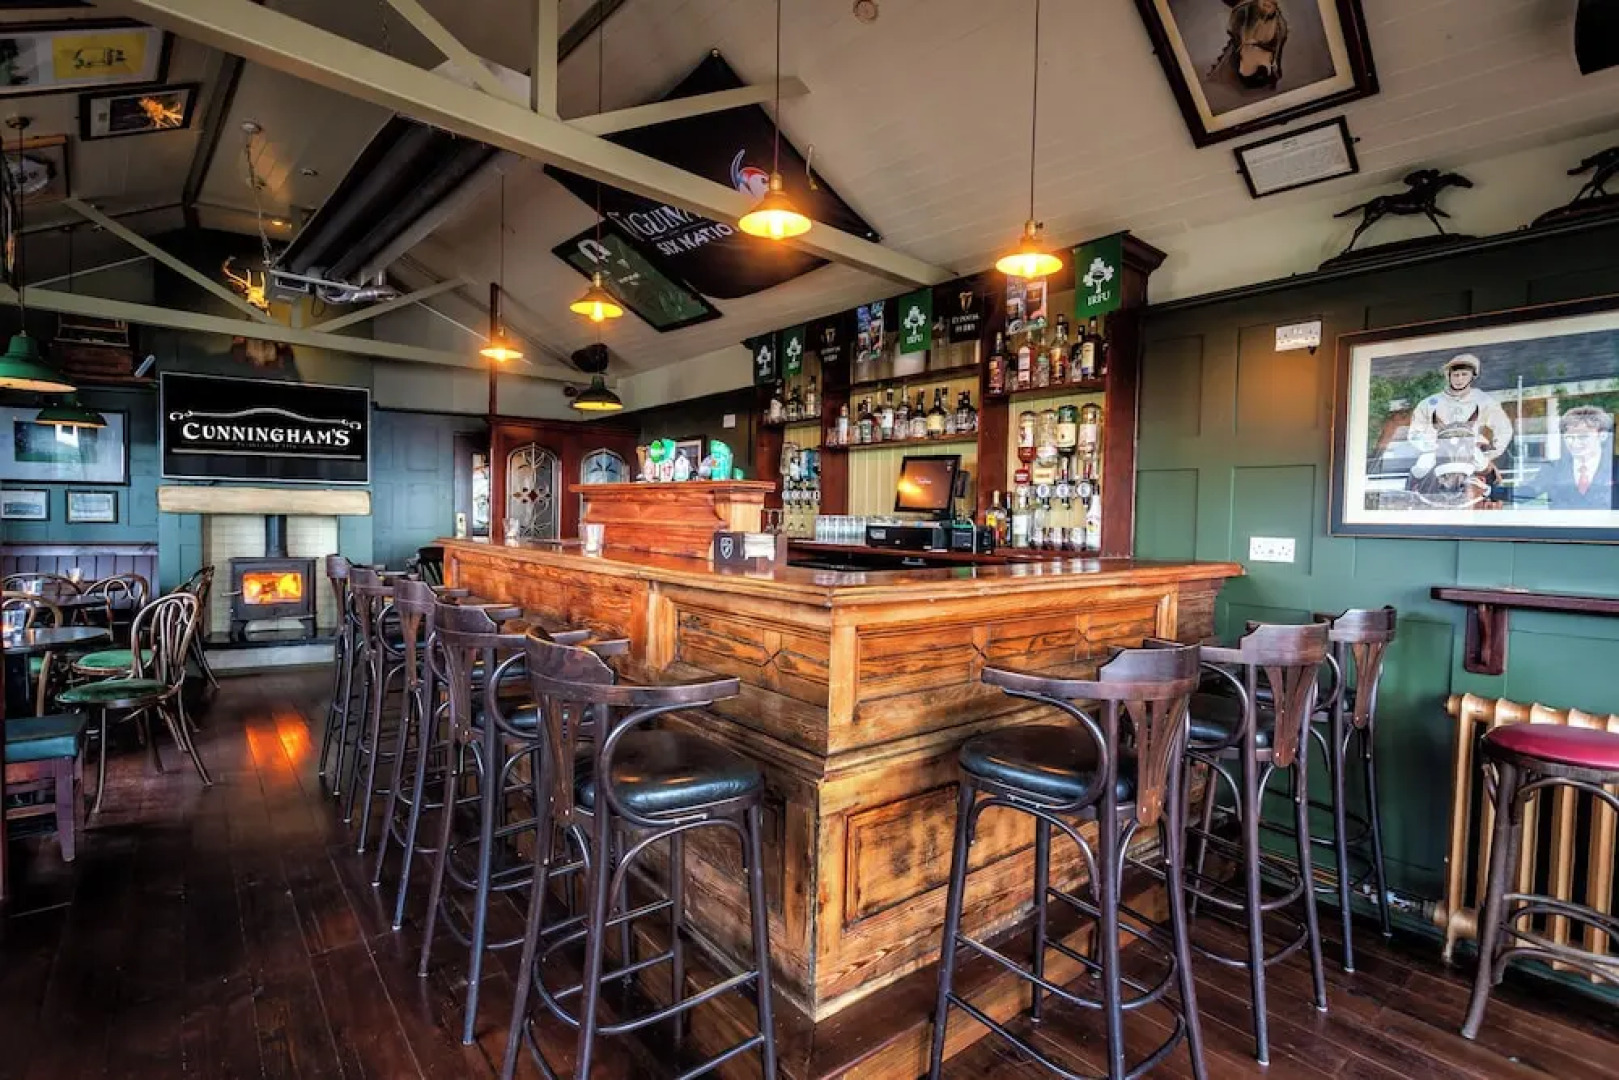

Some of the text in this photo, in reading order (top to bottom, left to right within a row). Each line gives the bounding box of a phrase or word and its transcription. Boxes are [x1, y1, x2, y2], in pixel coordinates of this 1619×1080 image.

[656, 222, 737, 255] SIX NATIO
[1087, 290, 1110, 306] IRFU
